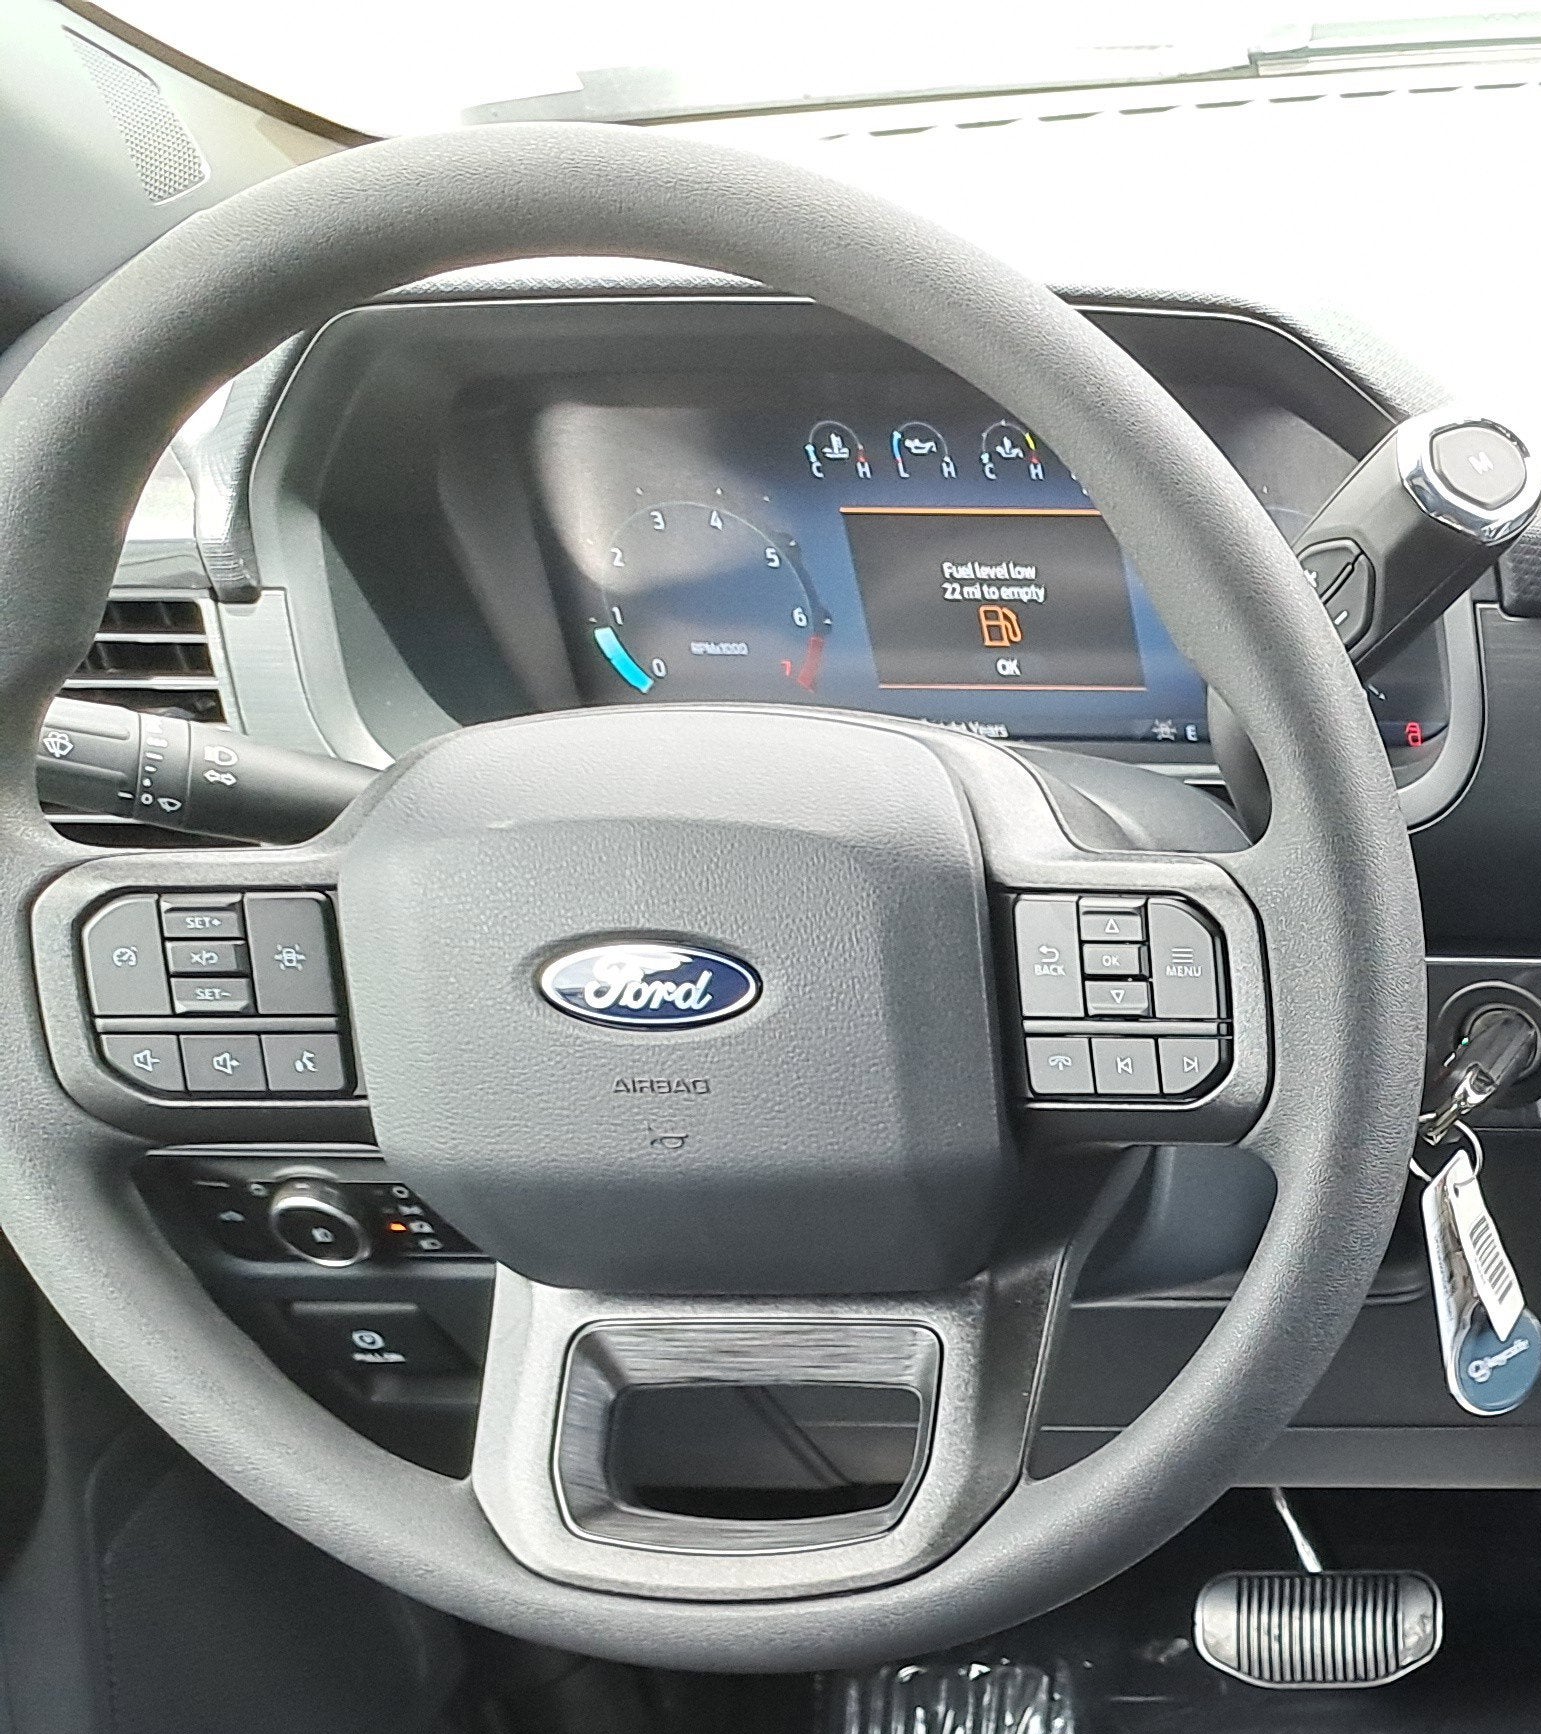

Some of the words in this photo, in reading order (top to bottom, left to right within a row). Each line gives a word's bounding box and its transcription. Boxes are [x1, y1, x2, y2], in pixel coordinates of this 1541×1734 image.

[811, 461, 824, 478] C
[856, 461, 872, 479] H
[941, 461, 957, 479] H
[984, 461, 997, 480] C
[1029, 462, 1044, 481] H
[650, 510, 666, 530] 3
[710, 510, 723, 531] 4
[611, 547, 625, 567] 2
[765, 547, 781, 568] 5
[942, 561, 974, 579] Fuel
[975, 561, 1009, 580] level
[1009, 560, 1036, 580] low
[941, 582, 962, 600] 22
[962, 582, 981, 600] mi
[982, 583, 999, 600] to
[1000, 583, 1045, 603] empty
[612, 606, 624, 626] 1
[792, 606, 808, 627] 6
[652, 658, 667, 678] 0
[781, 658, 792, 676] 7
[996, 658, 1021, 676] OK
[1034, 963, 1066, 977] BACK
[1101, 955, 1121, 967] OK
[583, 950, 714, 1011] Ford
[1165, 964, 1202, 978] MENU
[612, 1077, 712, 1095] AIRBAG
